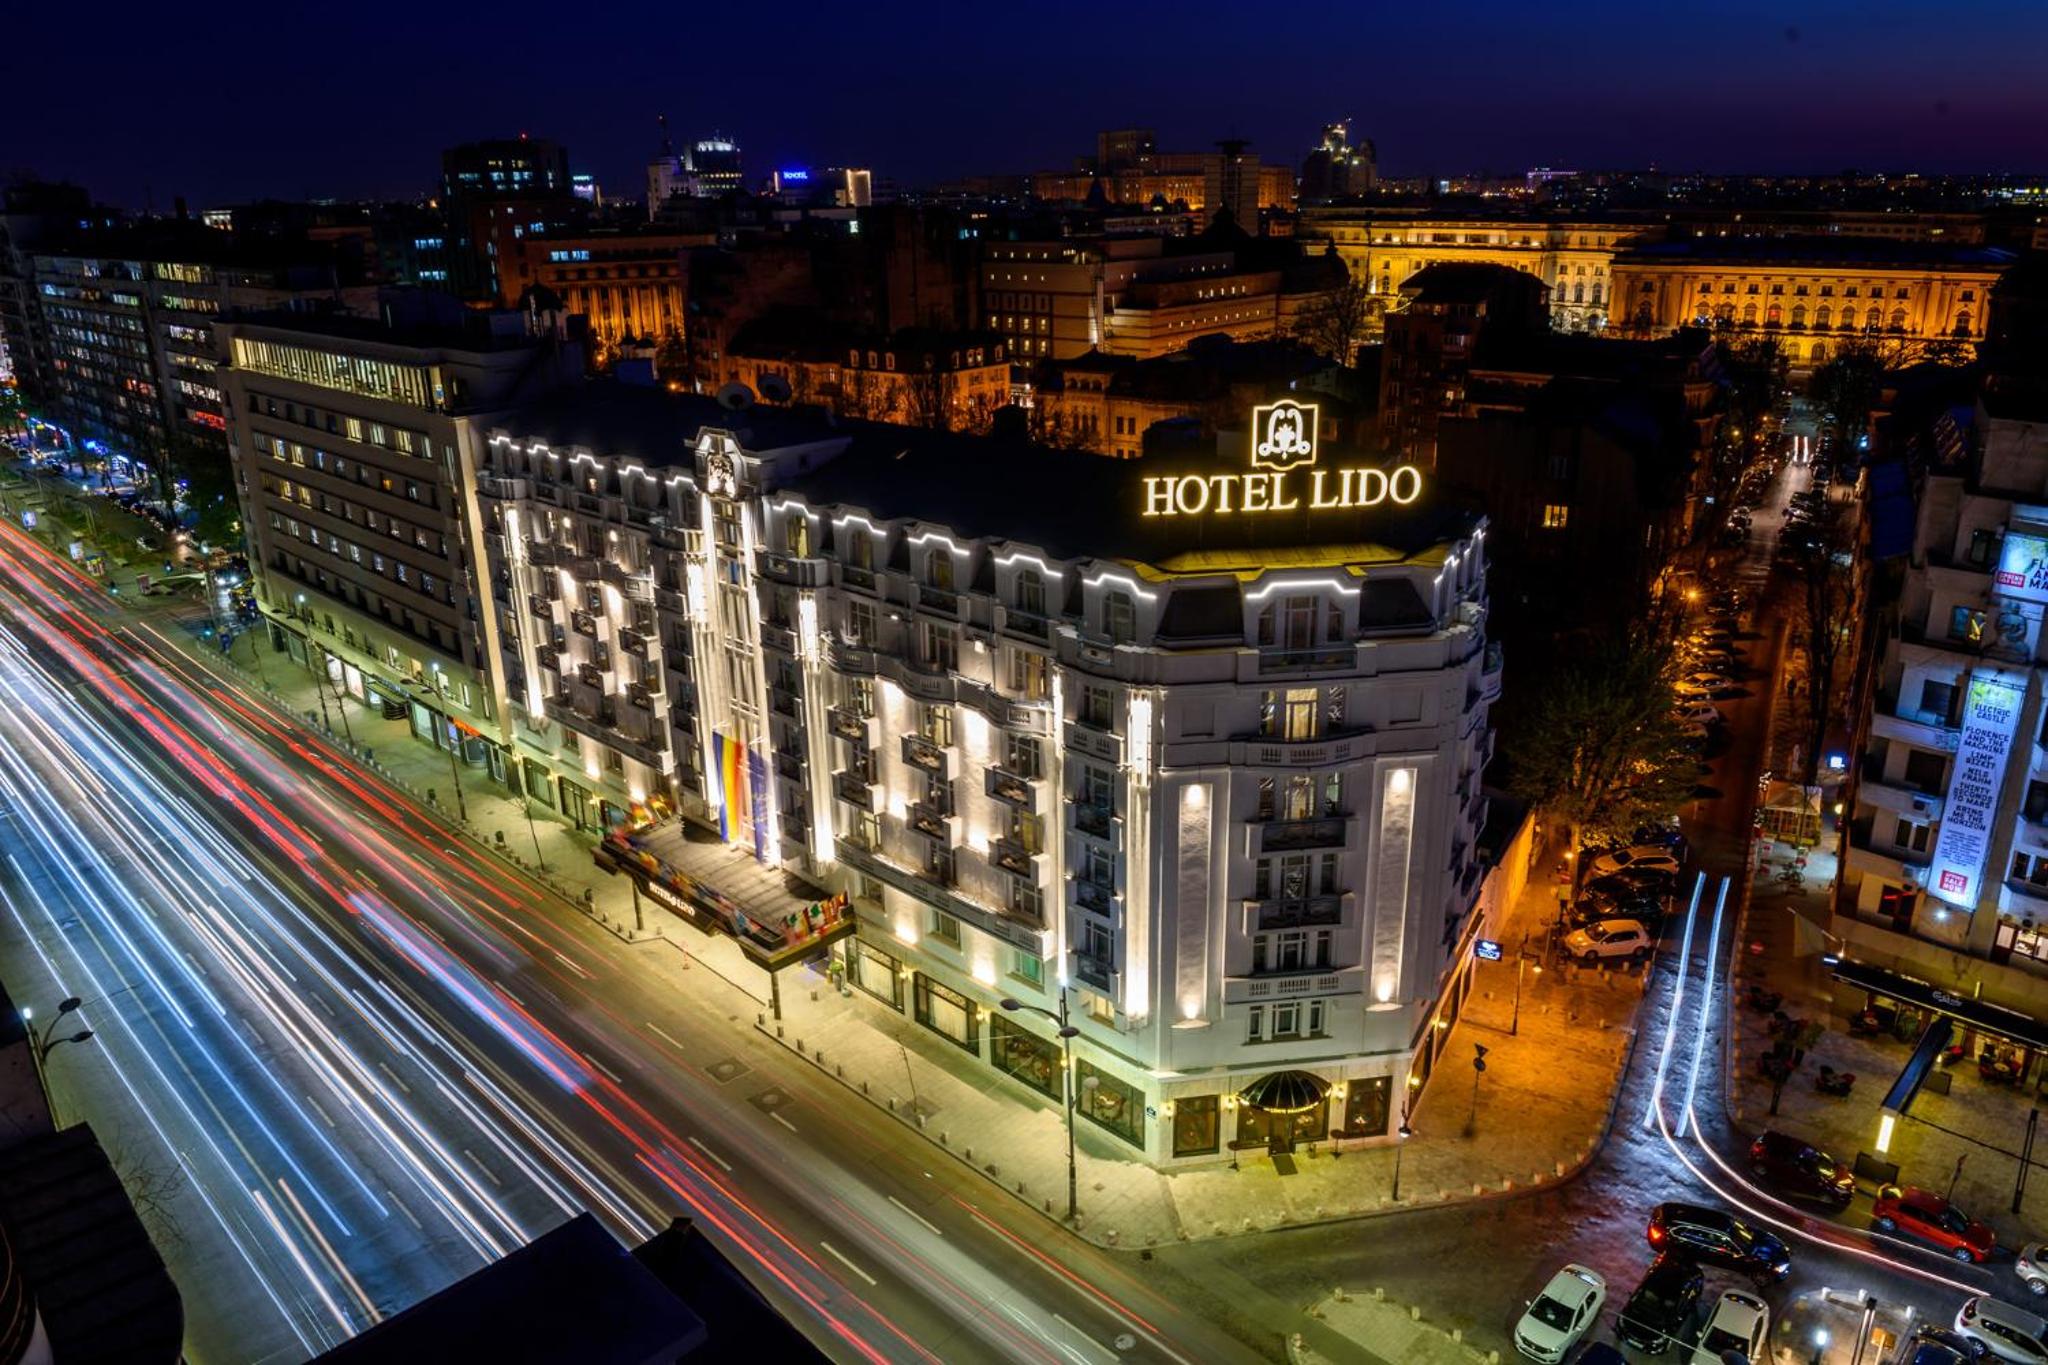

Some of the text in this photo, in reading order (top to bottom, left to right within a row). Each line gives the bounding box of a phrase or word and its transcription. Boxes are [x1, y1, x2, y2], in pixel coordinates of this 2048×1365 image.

[1142, 466, 1422, 516] HOTEL LIDO
[1975, 703, 2010, 717] ELECTRIC
[1976, 712, 2006, 724] CASTLE
[1965, 726, 2010, 742] FLORENCE
[1968, 734, 2004, 747] AND THE
[1964, 740, 2004, 755] MACHINE
[1971, 751, 1994, 761] LIMP
[1965, 757, 1996, 770] BIZKIT
[1968, 767, 1989, 777] NILS
[1962, 773, 1992, 786] FRAHM
[1953, 787, 1993, 803] SECONDS
[1961, 782, 1991, 795] THIRTY
[1966, 798, 1991, 809] MARS
[1956, 805, 1984, 817] BRING
[1947, 816, 1986, 831] HORIZON
[1968, 814, 1984, 824] THE
